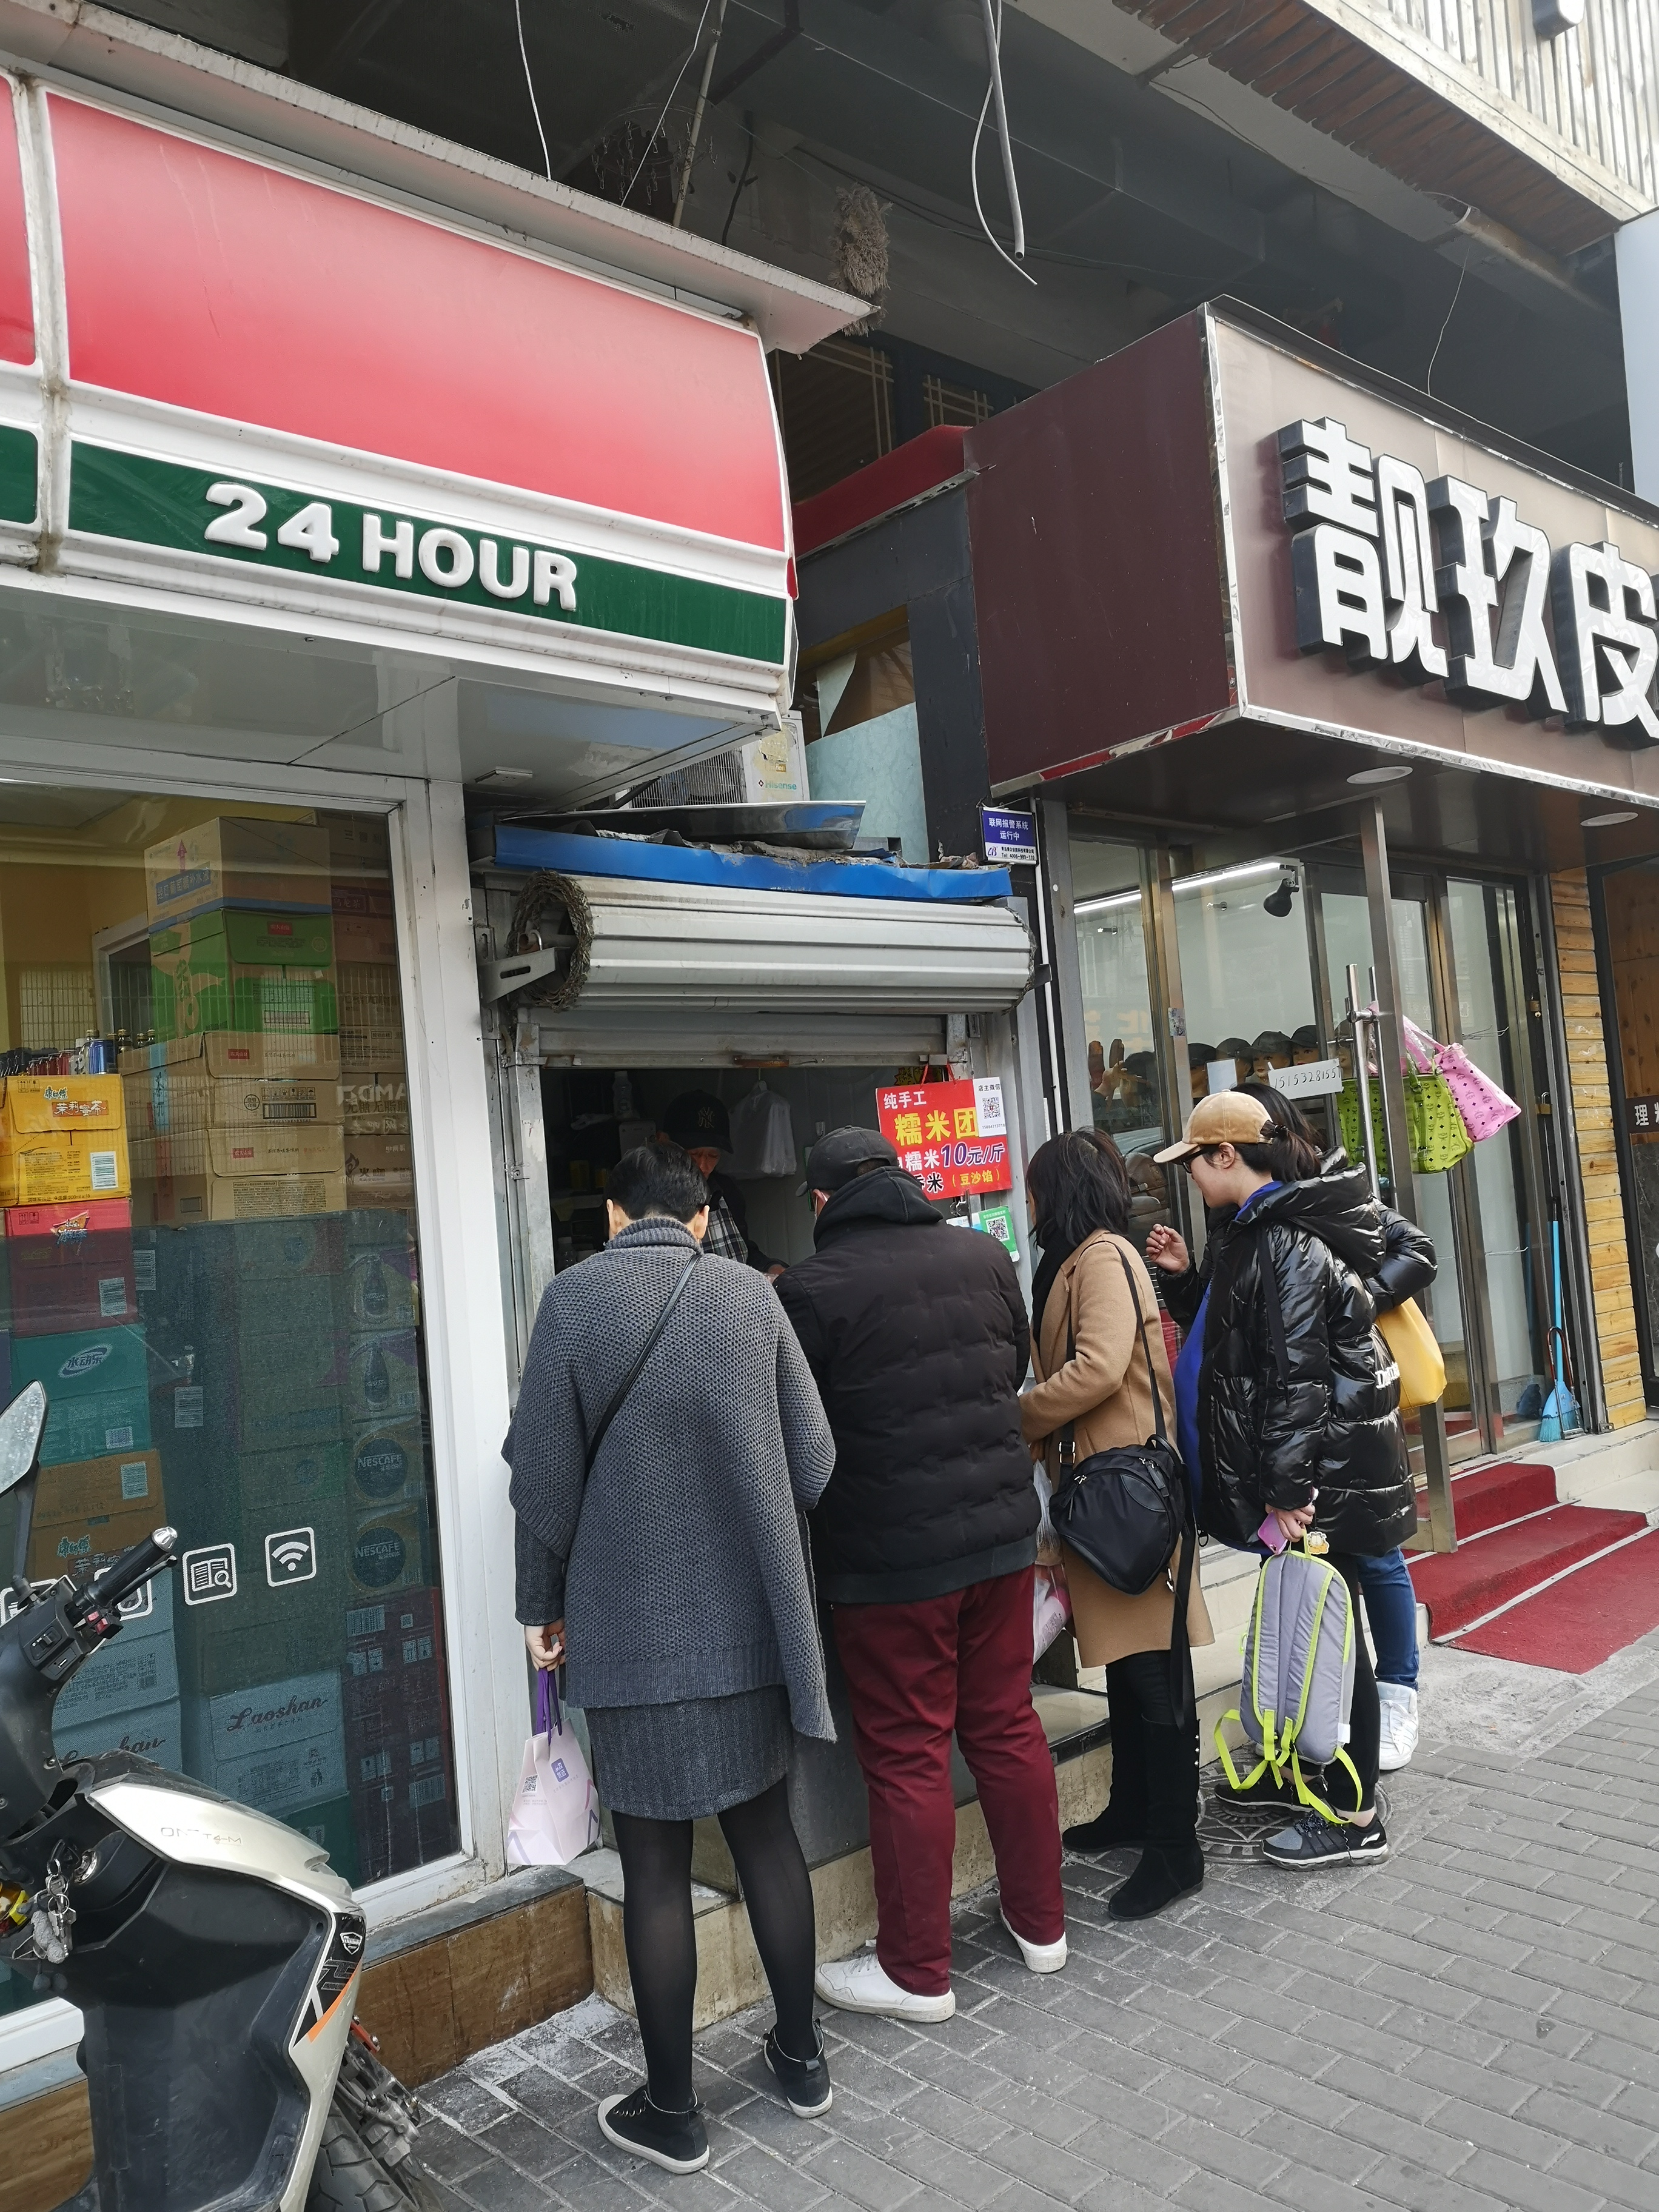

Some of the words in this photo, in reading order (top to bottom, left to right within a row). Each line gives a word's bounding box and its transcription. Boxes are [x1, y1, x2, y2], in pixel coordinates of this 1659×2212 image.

[204, 481, 339, 563] 24
[362, 512, 578, 612] HOUR
[988, 817, 1029, 830] 联网报警系统
[1000, 830, 1020, 841] 运行中
[978, 1083, 1001, 1091] 店主微信
[54, 1100, 106, 1116] 茉莉蜜茶
[883, 1090, 927, 1110] 纯手工
[894, 1107, 979, 1147] 糯米团
[67, 1354, 103, 1369] 水动乐
[226, 1695, 329, 1732] Laoshan
